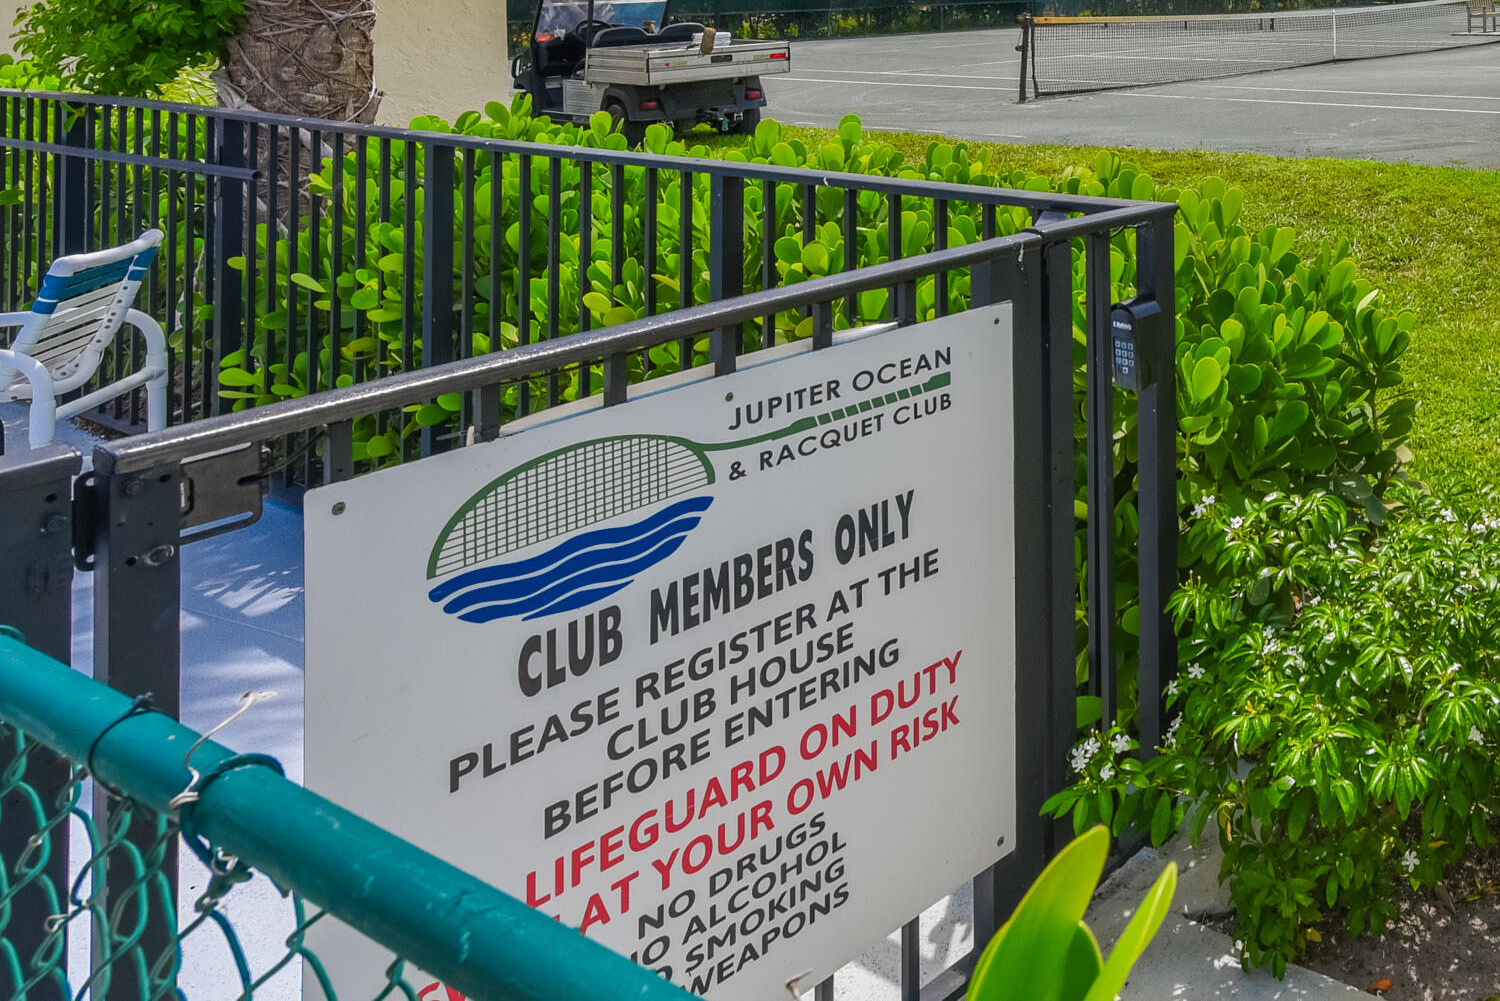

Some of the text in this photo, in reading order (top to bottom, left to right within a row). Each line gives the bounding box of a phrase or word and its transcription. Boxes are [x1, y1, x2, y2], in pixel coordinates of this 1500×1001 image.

[727, 346, 952, 431] JUPITER OCEAN
[728, 393, 953, 482] & RACQUET CLUB
[518, 489, 915, 698] CLUB MEMBERS ONLY
[449, 548, 940, 794] PLEASE REGISTER AT THE
[544, 637, 900, 840] BEFORE ENTERING
[606, 622, 854, 761] CLUB HOUSE
[525, 650, 963, 909] LIFEGUARD ON DUTY
[579, 697, 960, 936] AT YOUR OWN RISK
[630, 831, 847, 966] O ALCOHOL
[638, 812, 826, 941] NO DRUGS
[685, 856, 845, 973] SMOKING
